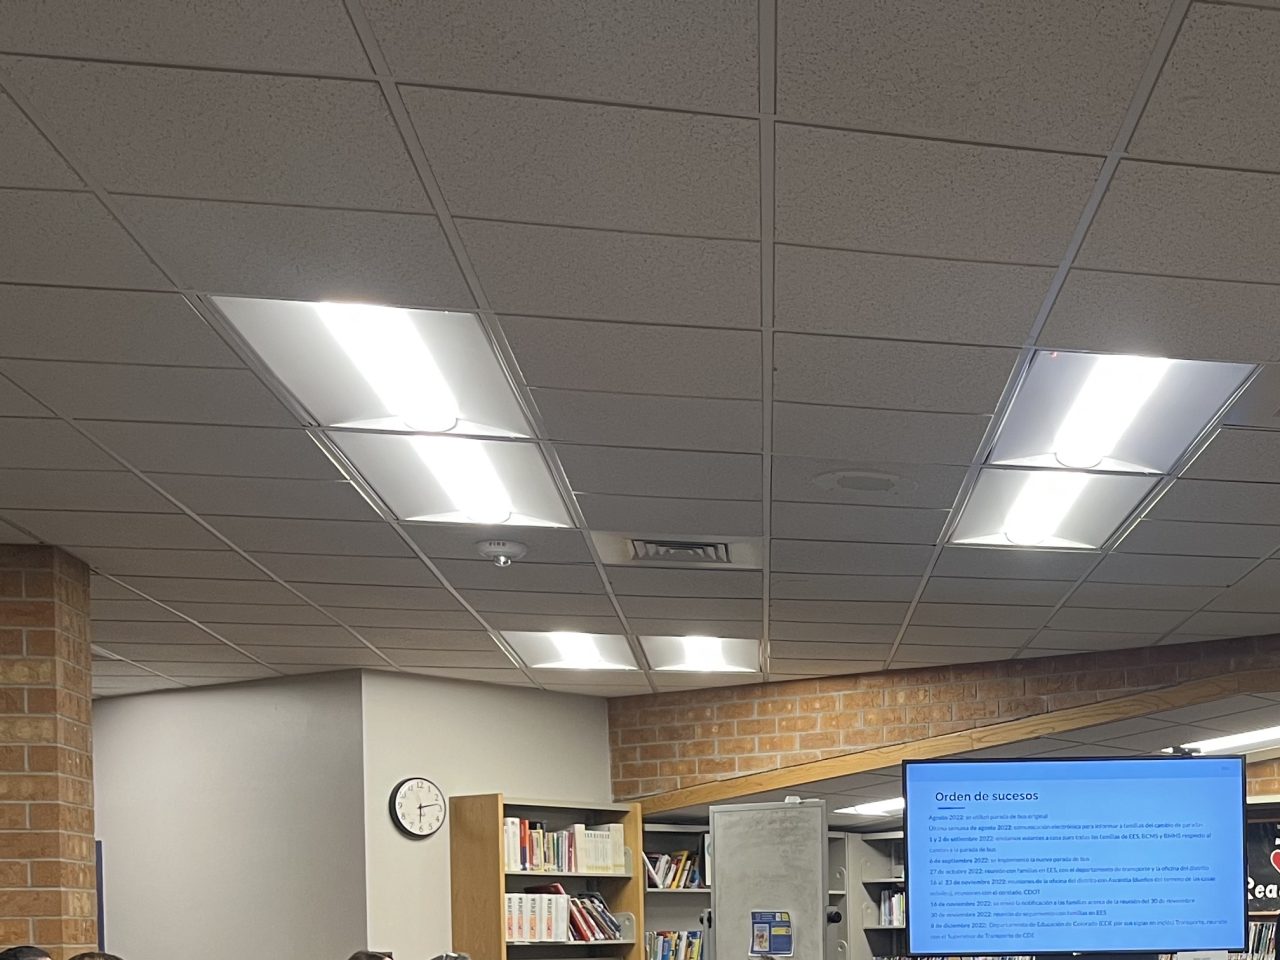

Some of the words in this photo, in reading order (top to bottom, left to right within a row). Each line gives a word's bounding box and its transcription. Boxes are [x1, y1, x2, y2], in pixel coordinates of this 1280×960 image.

[935, 792, 971, 801] Orden
[974, 792, 989, 801] de
[992, 792, 1039, 801] sucesos
